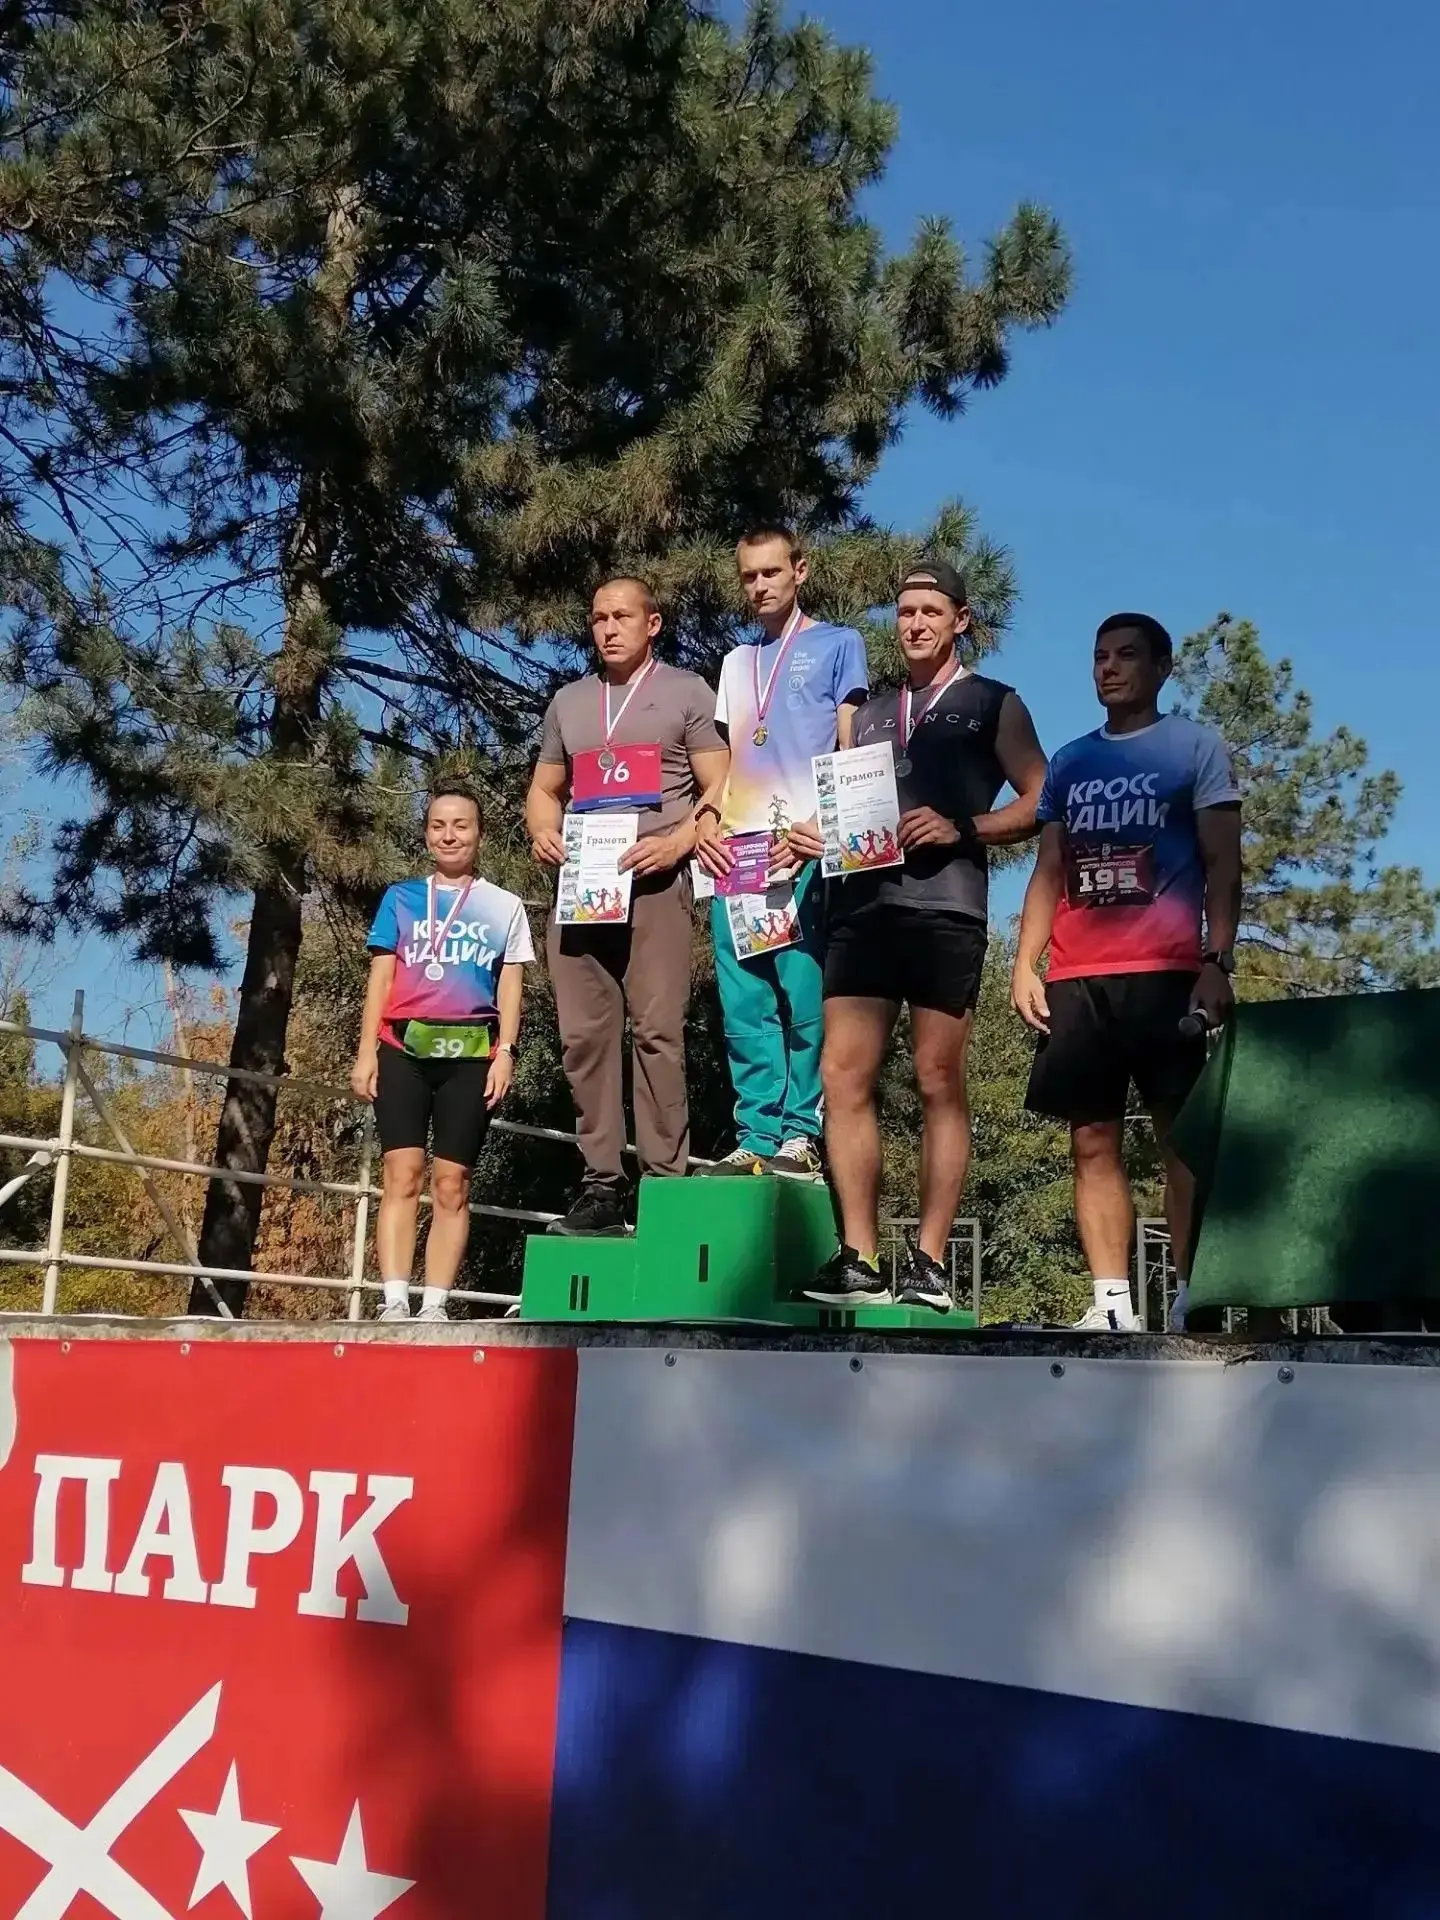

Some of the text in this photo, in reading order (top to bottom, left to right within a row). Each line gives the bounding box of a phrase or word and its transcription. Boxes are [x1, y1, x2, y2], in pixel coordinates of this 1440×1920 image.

[602, 761, 630, 784] 76
[840, 769, 885, 785] Грамота
[1067, 773, 1159, 807] КРОСС
[586, 835, 627, 847] Грамота
[1079, 868, 1138, 893] 195
[404, 940, 496, 971] НАЦИИ
[430, 1038, 465, 1058] 39
[21, 1454, 414, 1626] ПАРК
